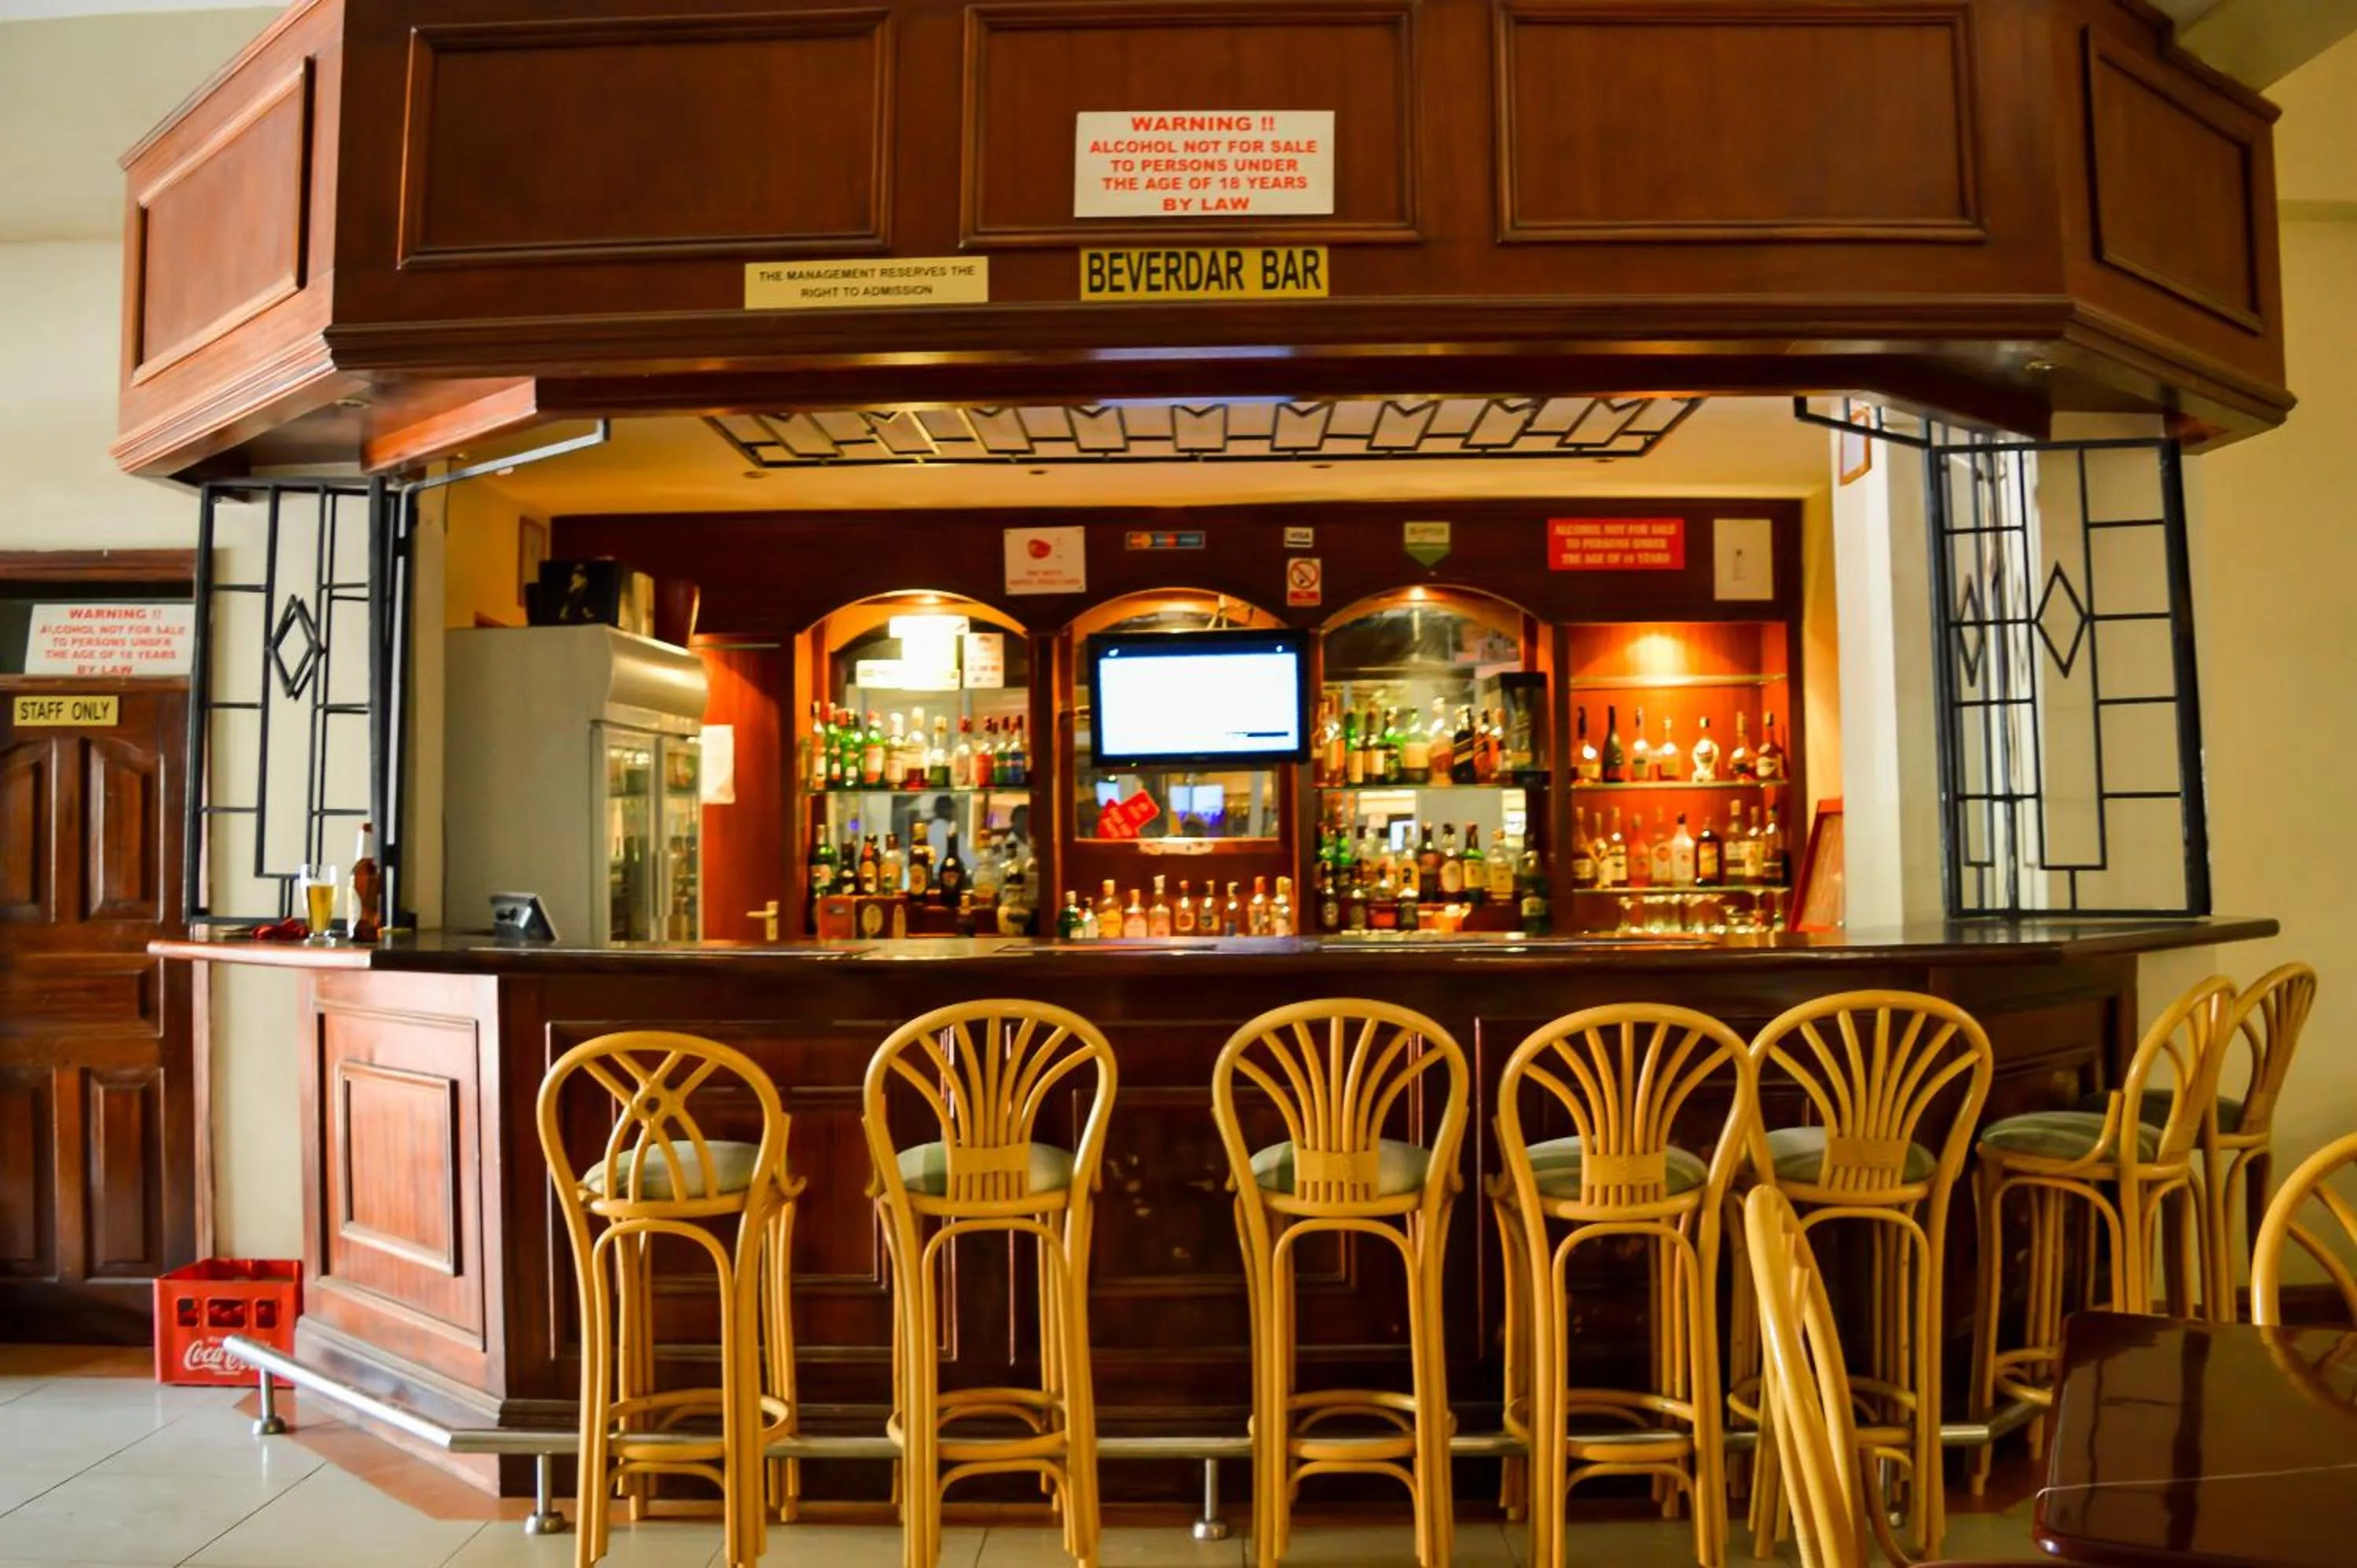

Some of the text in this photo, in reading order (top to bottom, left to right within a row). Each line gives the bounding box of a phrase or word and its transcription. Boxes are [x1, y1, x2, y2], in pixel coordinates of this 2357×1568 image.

[1131, 116, 1275, 132] WARNING !!
[1090, 140, 1318, 153] ALCOHOL NOT FOR SALE
[1110, 159, 1299, 172] TO PERSONS UNDER
[1102, 176, 1307, 190] THE AGE OF 18 YEARS
[1163, 196, 1251, 211] BY LAW
[759, 266, 976, 282] THE MANAGEMENT RESERVES THE
[1087, 249, 1321, 292] BEVERDAR BAR
[801, 285, 933, 299] RIGHT TO ADMISSION
[69, 610, 147, 619] WARNING
[41, 625, 185, 635] ALCOHOL NOT FOR SALE
[53, 637, 171, 647] TO PERSONS UNDER
[46, 650, 68, 659] THE
[72, 650, 95, 659] AGE
[100, 650, 115, 658] OF
[138, 650, 176, 658] YEARS
[77, 665, 134, 676] BY LAW
[20, 702, 111, 720] STAFF ONLY
